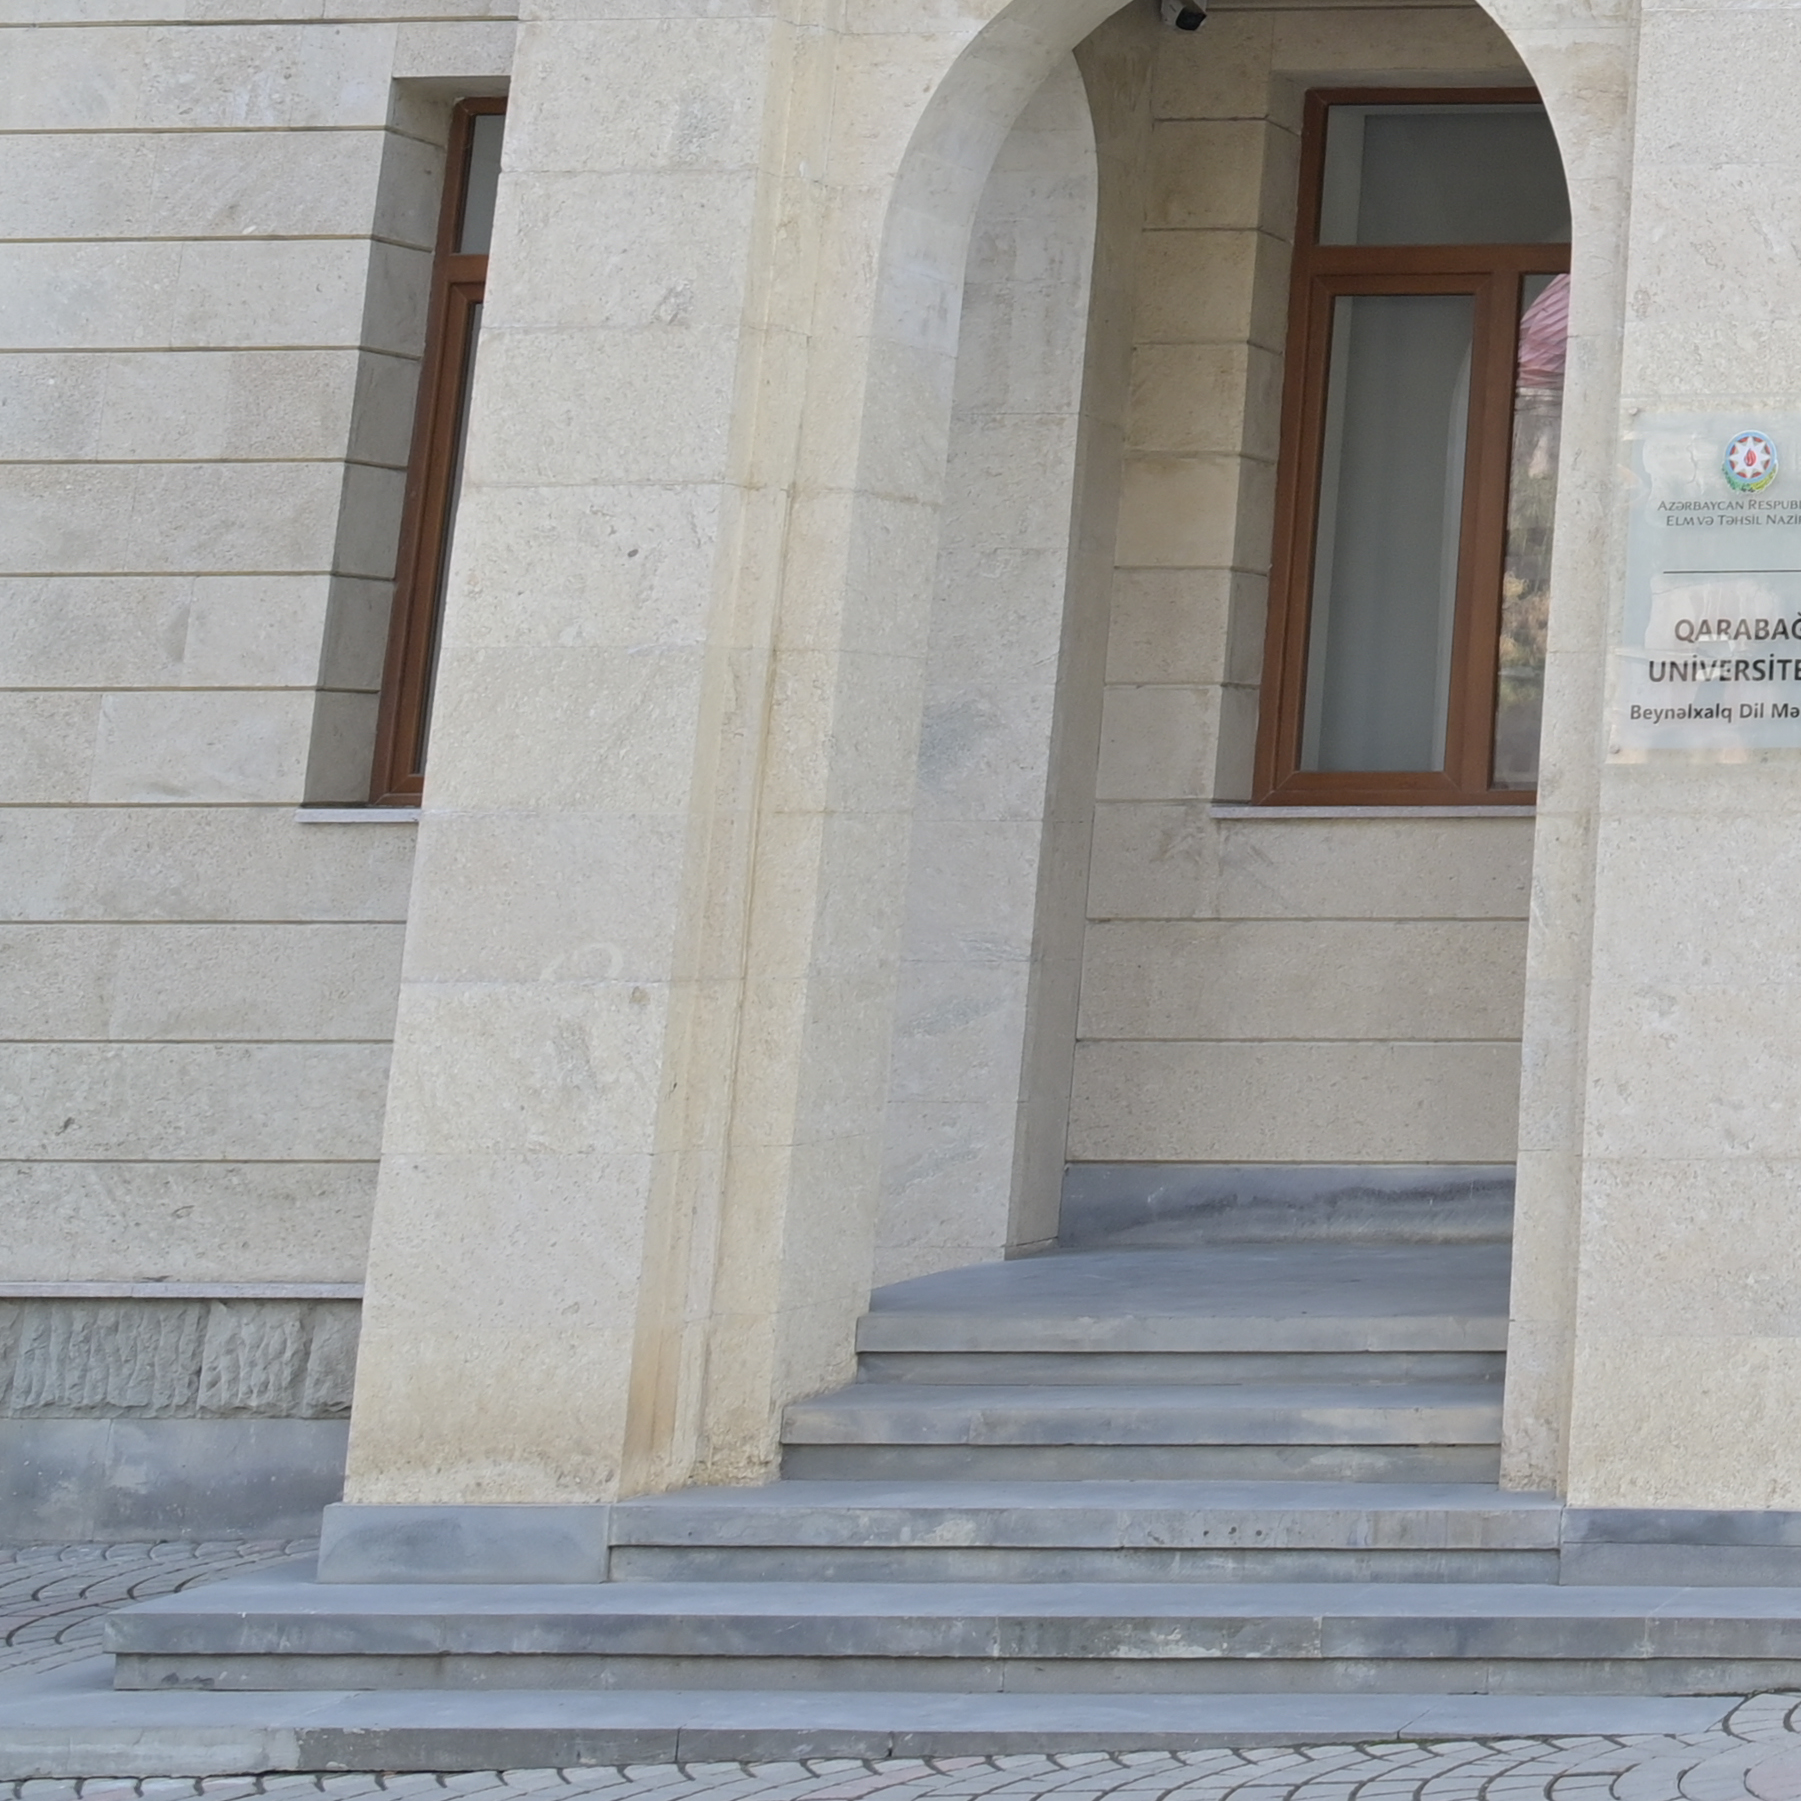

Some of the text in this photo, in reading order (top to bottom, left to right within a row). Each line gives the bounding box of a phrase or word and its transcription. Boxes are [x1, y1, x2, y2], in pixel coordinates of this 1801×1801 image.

[1657, 500, 1744, 511] AZƏRBAYCAN
[1666, 515, 1696, 527] ELM
[1717, 512, 1762, 526] TƏHSİL
[1630, 703, 1732, 724] Beynəlxalq
[1740, 702, 1764, 719] Dil
